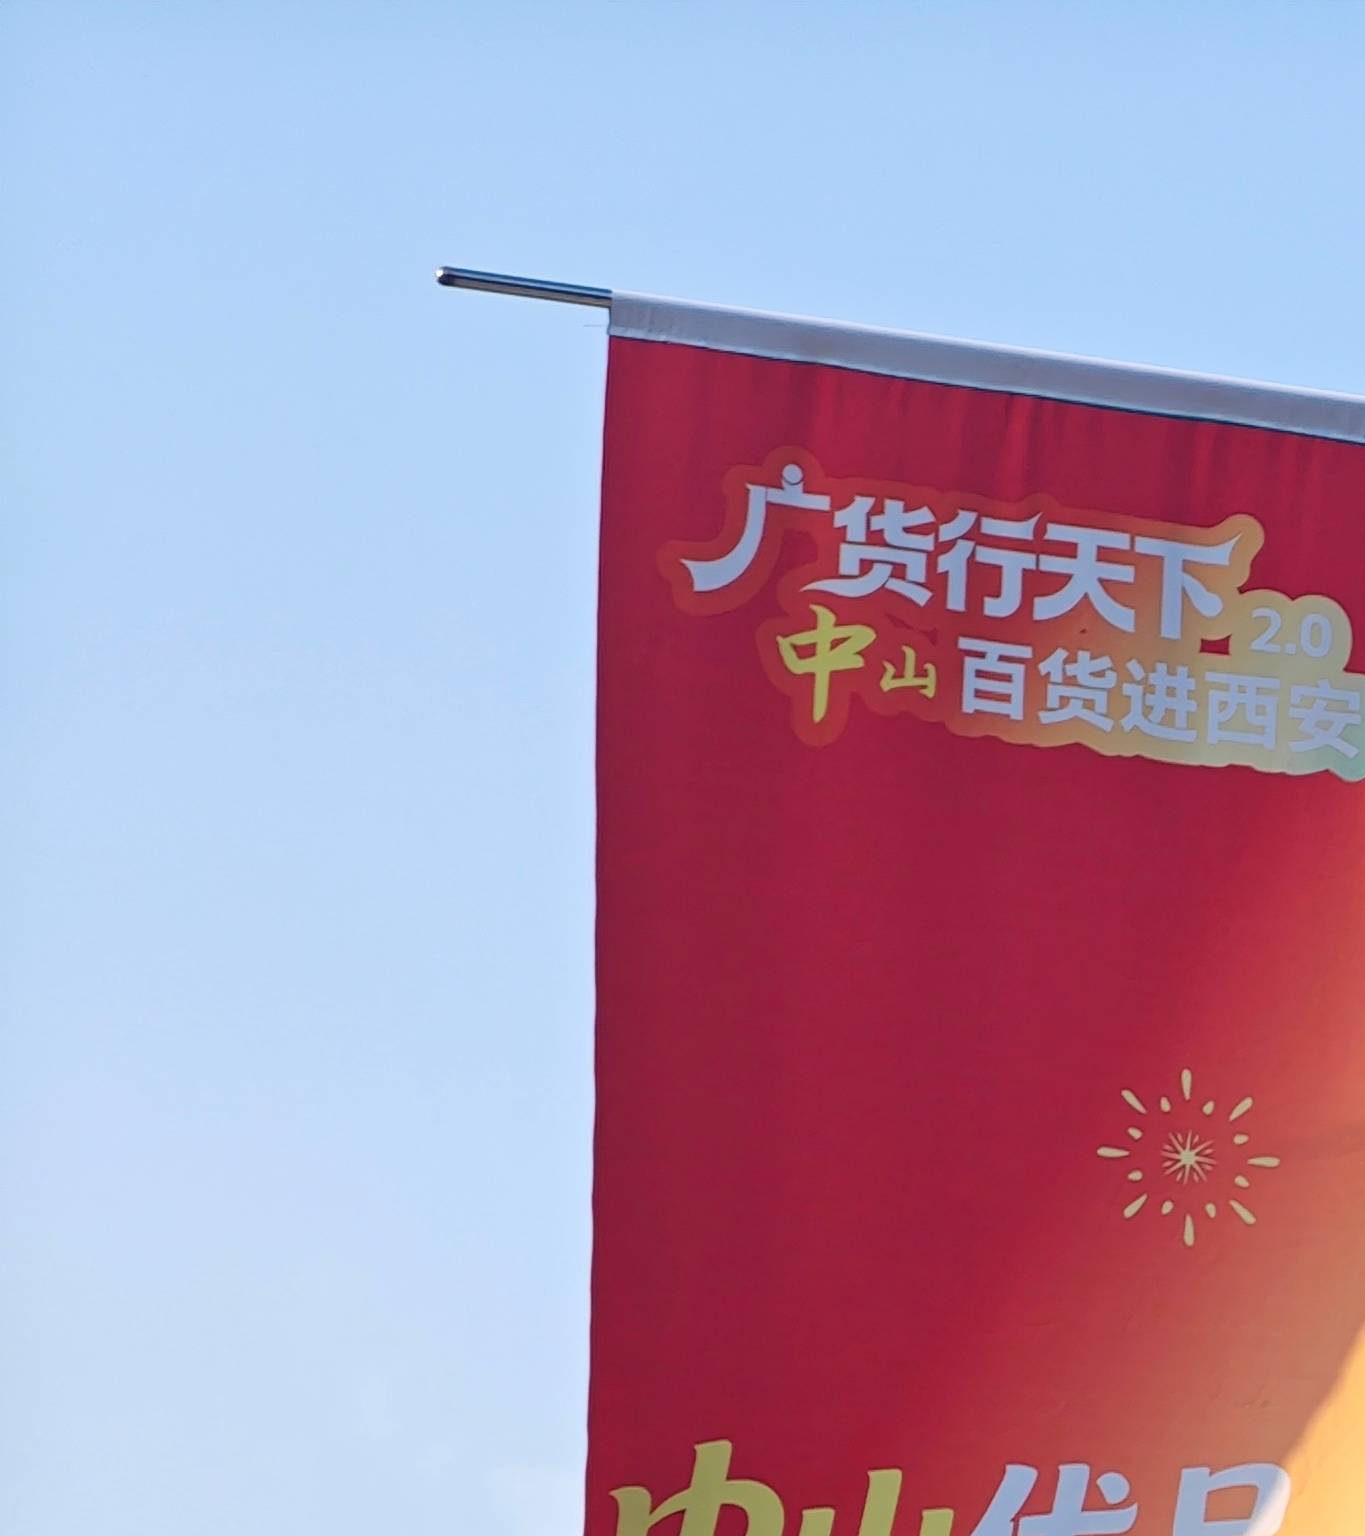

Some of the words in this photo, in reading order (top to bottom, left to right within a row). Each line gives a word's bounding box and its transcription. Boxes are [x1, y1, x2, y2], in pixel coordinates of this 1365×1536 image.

[681, 464, 1241, 639] 广货行天下
[1250, 606, 1333, 658] 2.0
